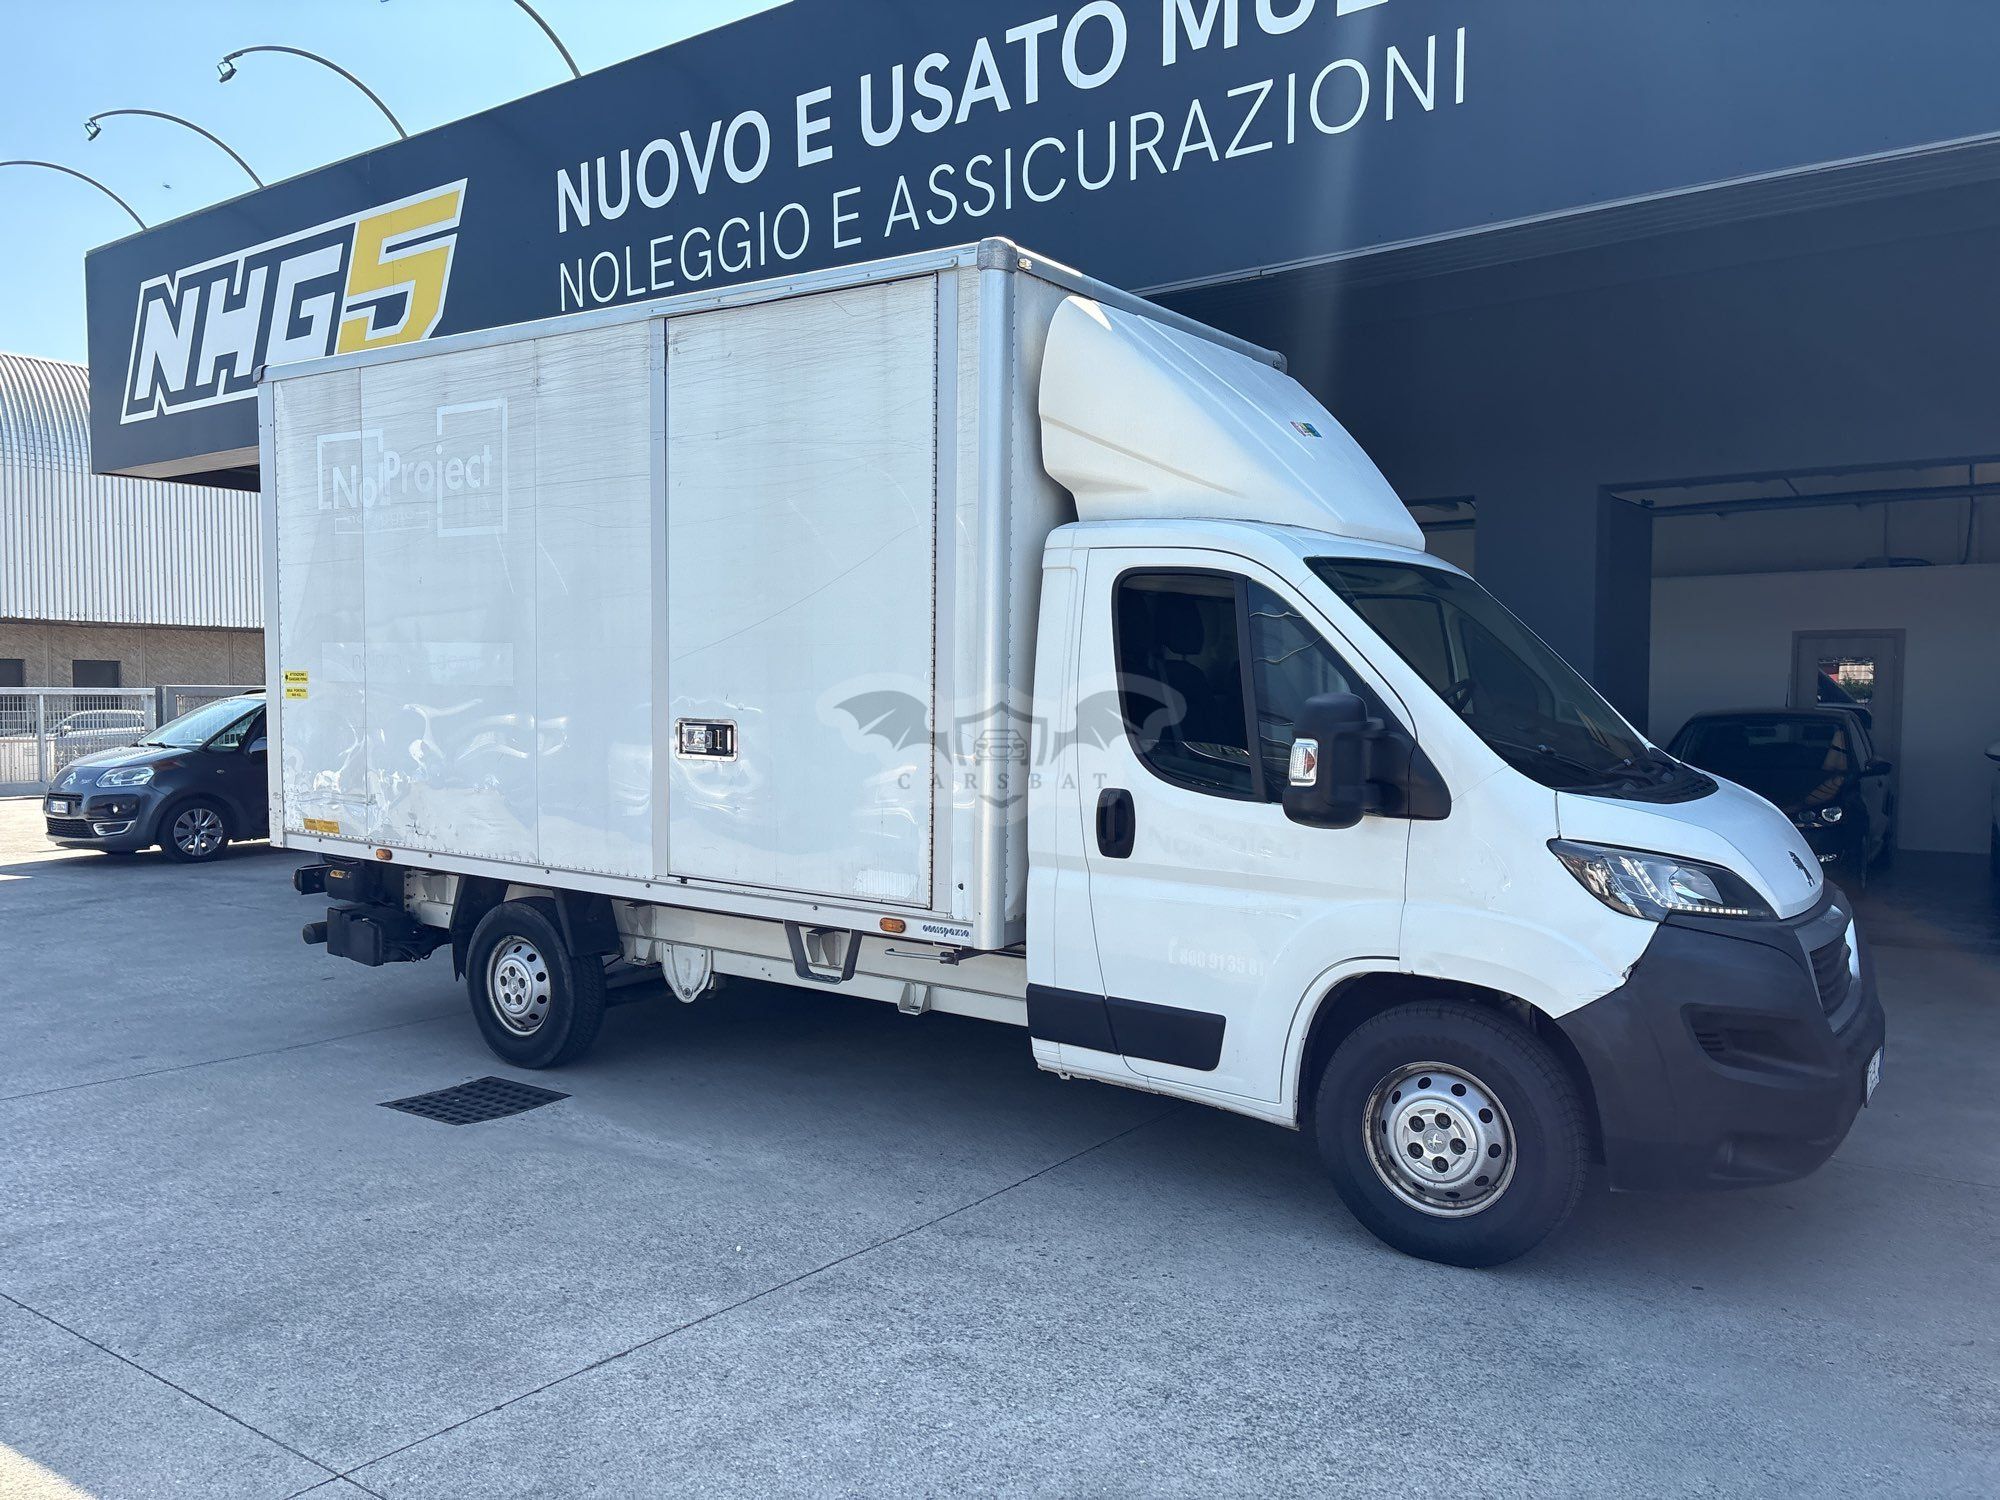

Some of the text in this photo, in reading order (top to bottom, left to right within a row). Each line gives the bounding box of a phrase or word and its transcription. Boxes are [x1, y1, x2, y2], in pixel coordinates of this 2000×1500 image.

[557, 110, 771, 234] NUOVO
[796, 86, 834, 168] E
[860, 0, 1128, 147] USATO
[559, 202, 810, 312] NOLEGGIO
[833, 187, 862, 249] E
[884, 27, 1466, 238] ASSICURAZIONI
